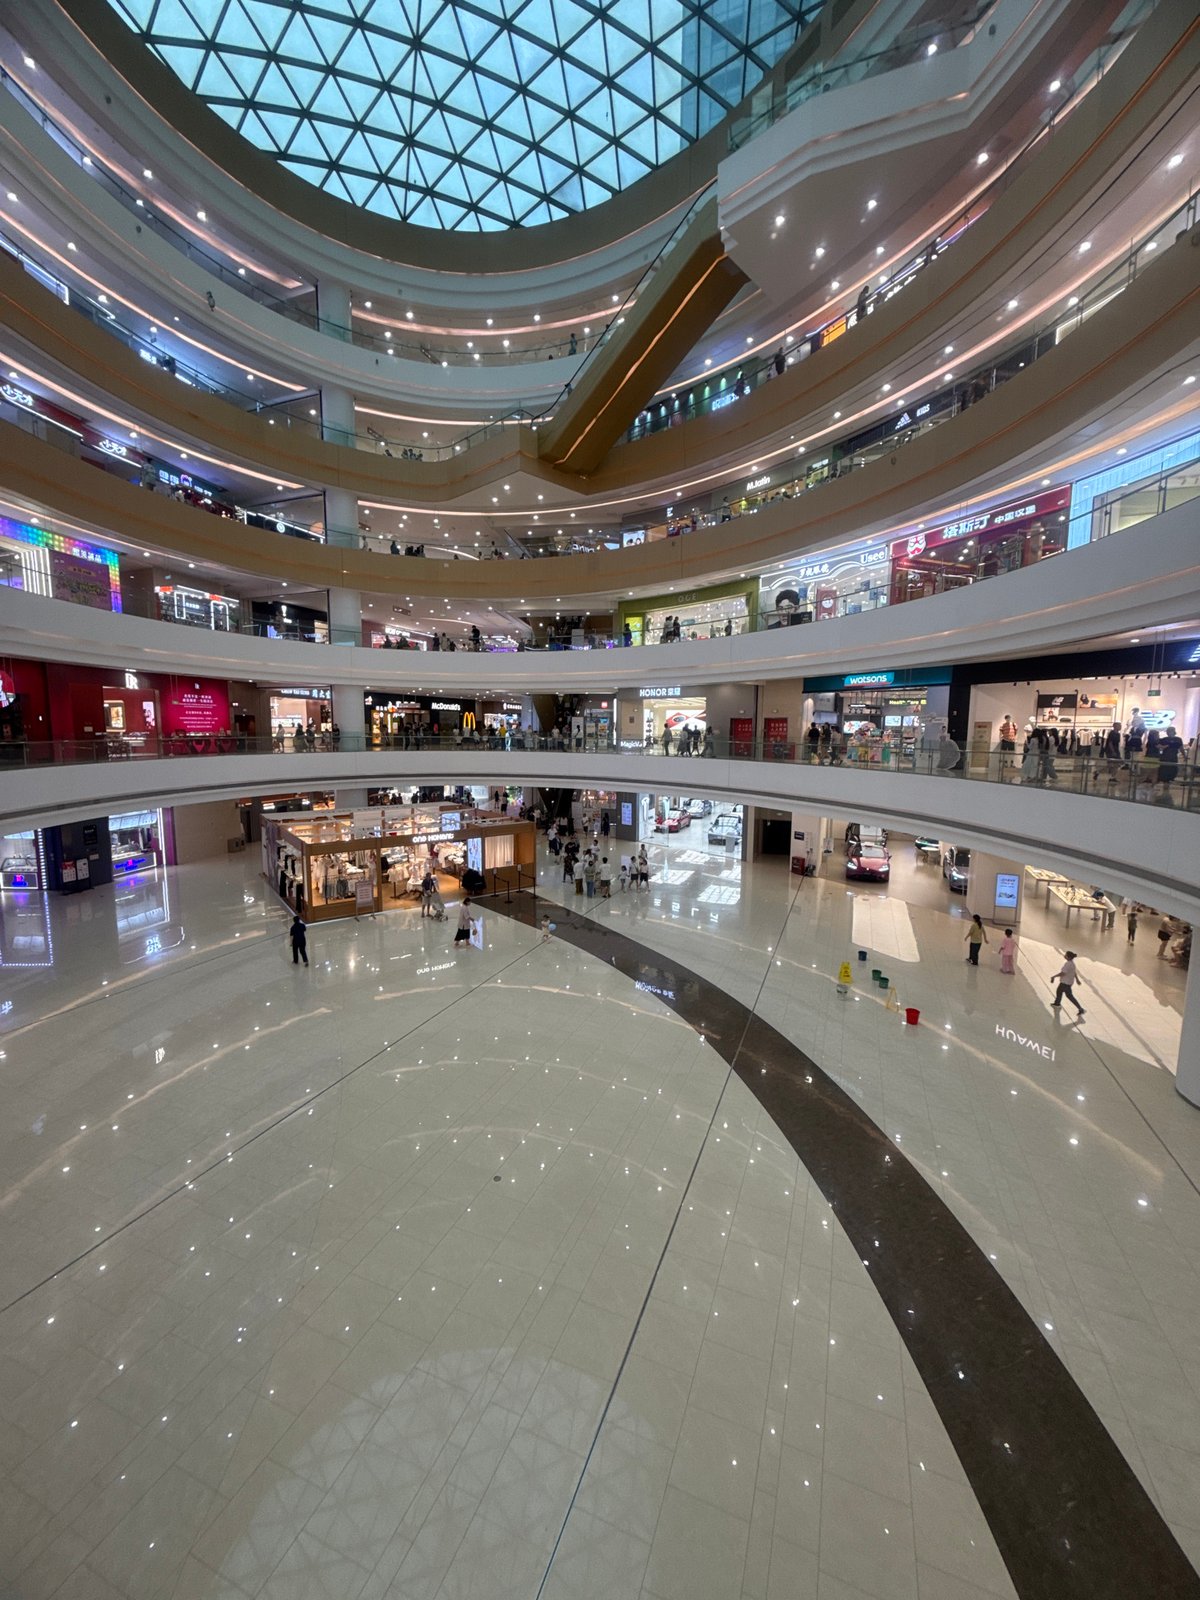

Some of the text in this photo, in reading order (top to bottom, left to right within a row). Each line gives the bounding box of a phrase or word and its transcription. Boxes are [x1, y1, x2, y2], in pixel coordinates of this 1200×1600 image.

[943, 514, 991, 539] 塔斯汀
[850, 674, 887, 685] watsons
[640, 688, 667, 698] HONOR
[431, 702, 461, 711] McDonald's
